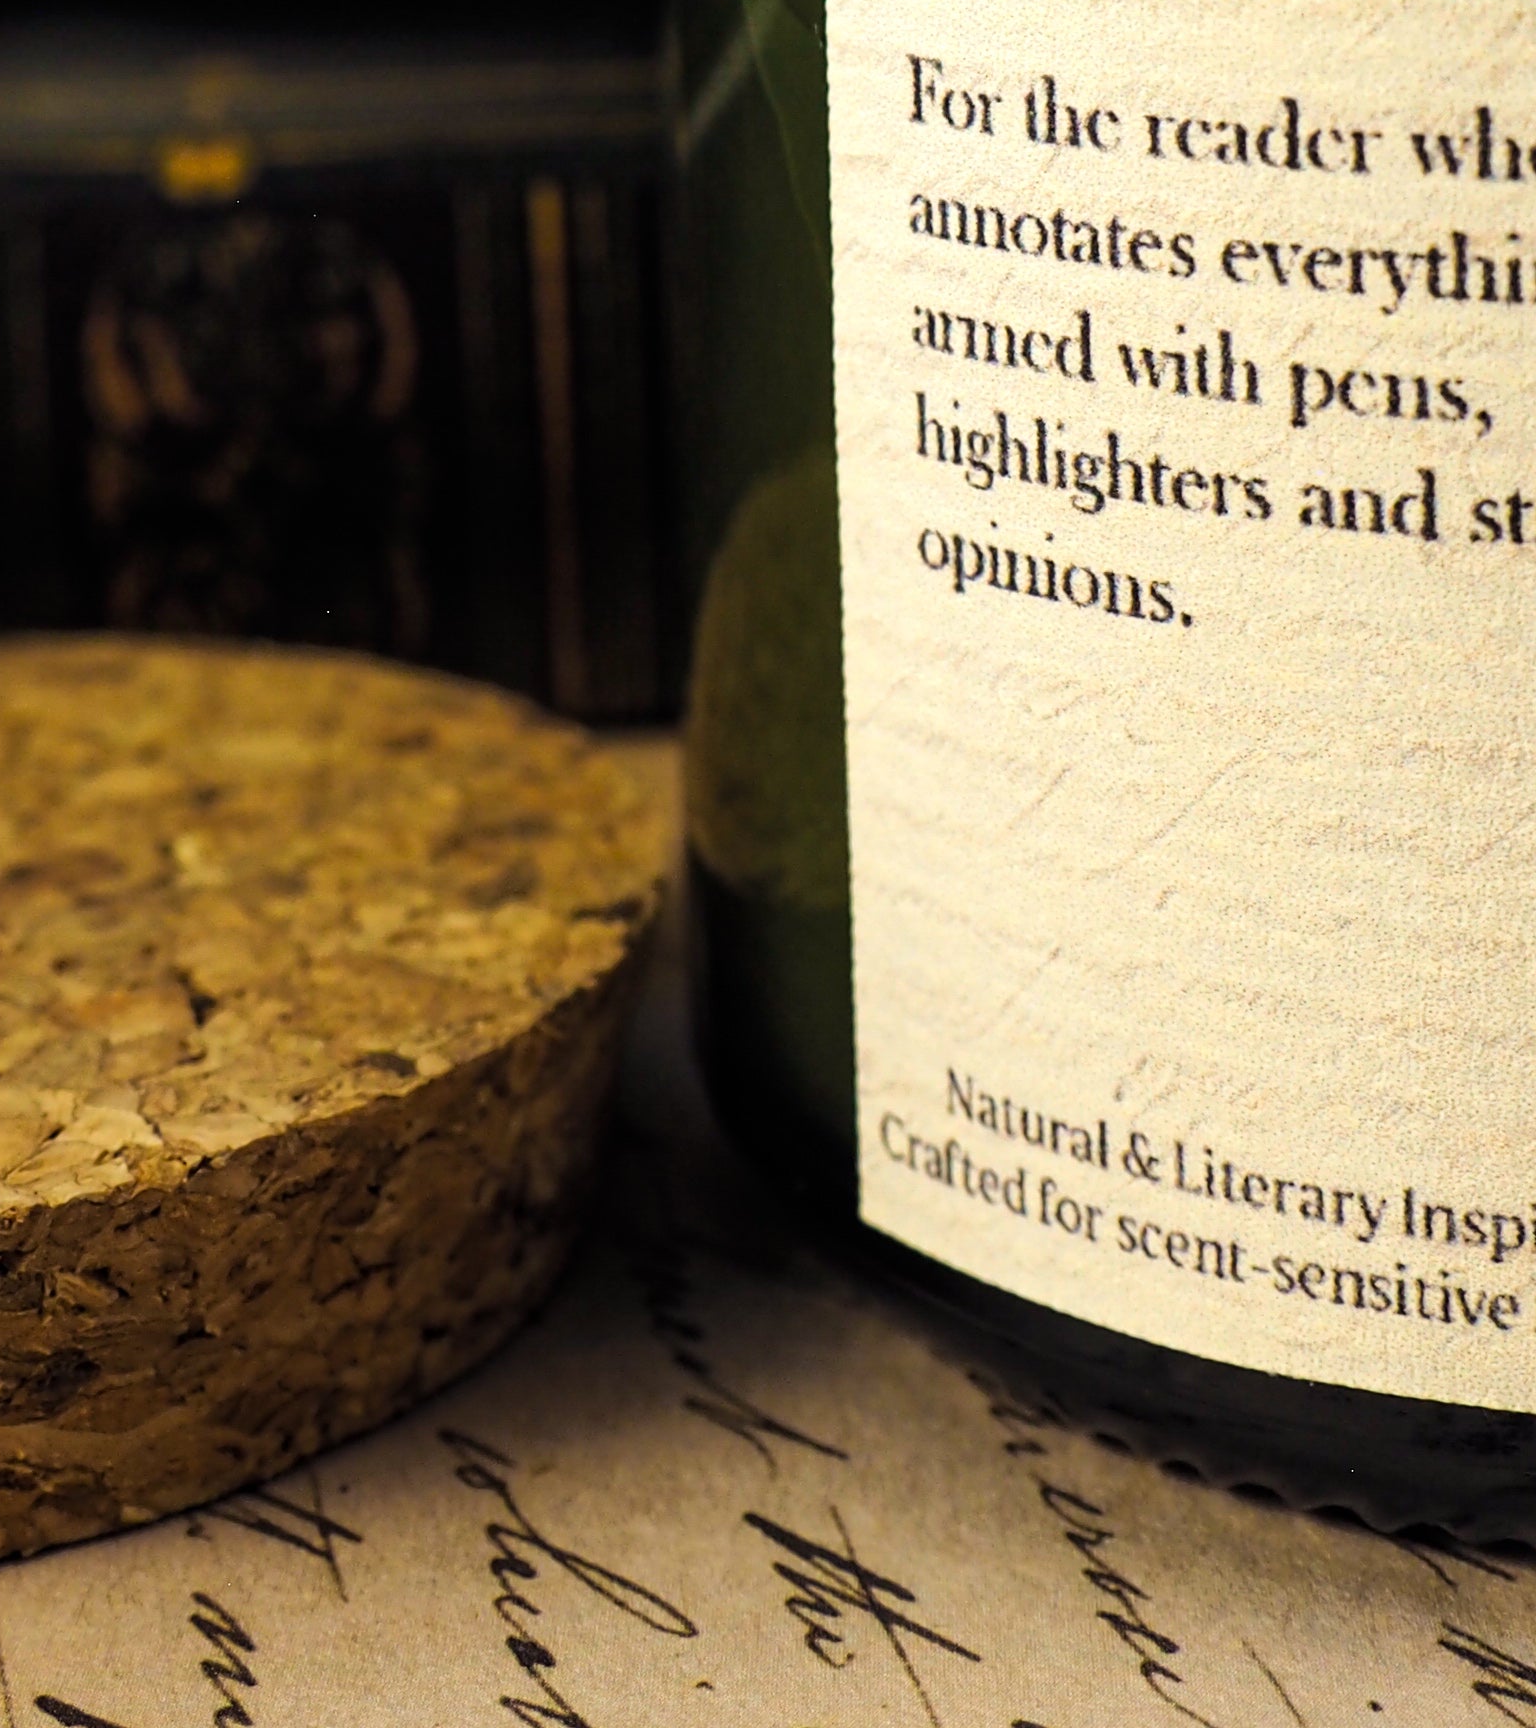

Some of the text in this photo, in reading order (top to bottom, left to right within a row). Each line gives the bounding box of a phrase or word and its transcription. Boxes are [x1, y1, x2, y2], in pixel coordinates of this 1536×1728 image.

[906, 52, 1003, 136] For
[1024, 75, 1122, 152] the
[1144, 97, 1383, 175] reader
[908, 187, 1198, 279] annotates
[911, 300, 1497, 438] armed with pens,
[912, 392, 1269, 520] highlighters
[1298, 467, 1441, 544] and
[916, 520, 1196, 628] opinions.
[878, 1111, 1029, 1216] Crafted
[1039, 1179, 1106, 1243] for
[1118, 1216, 1521, 1335] scent-sensitive
[945, 1067, 1108, 1172] Natural
[1124, 1130, 1162, 1182] &
[1175, 1139, 1388, 1243] Literary
